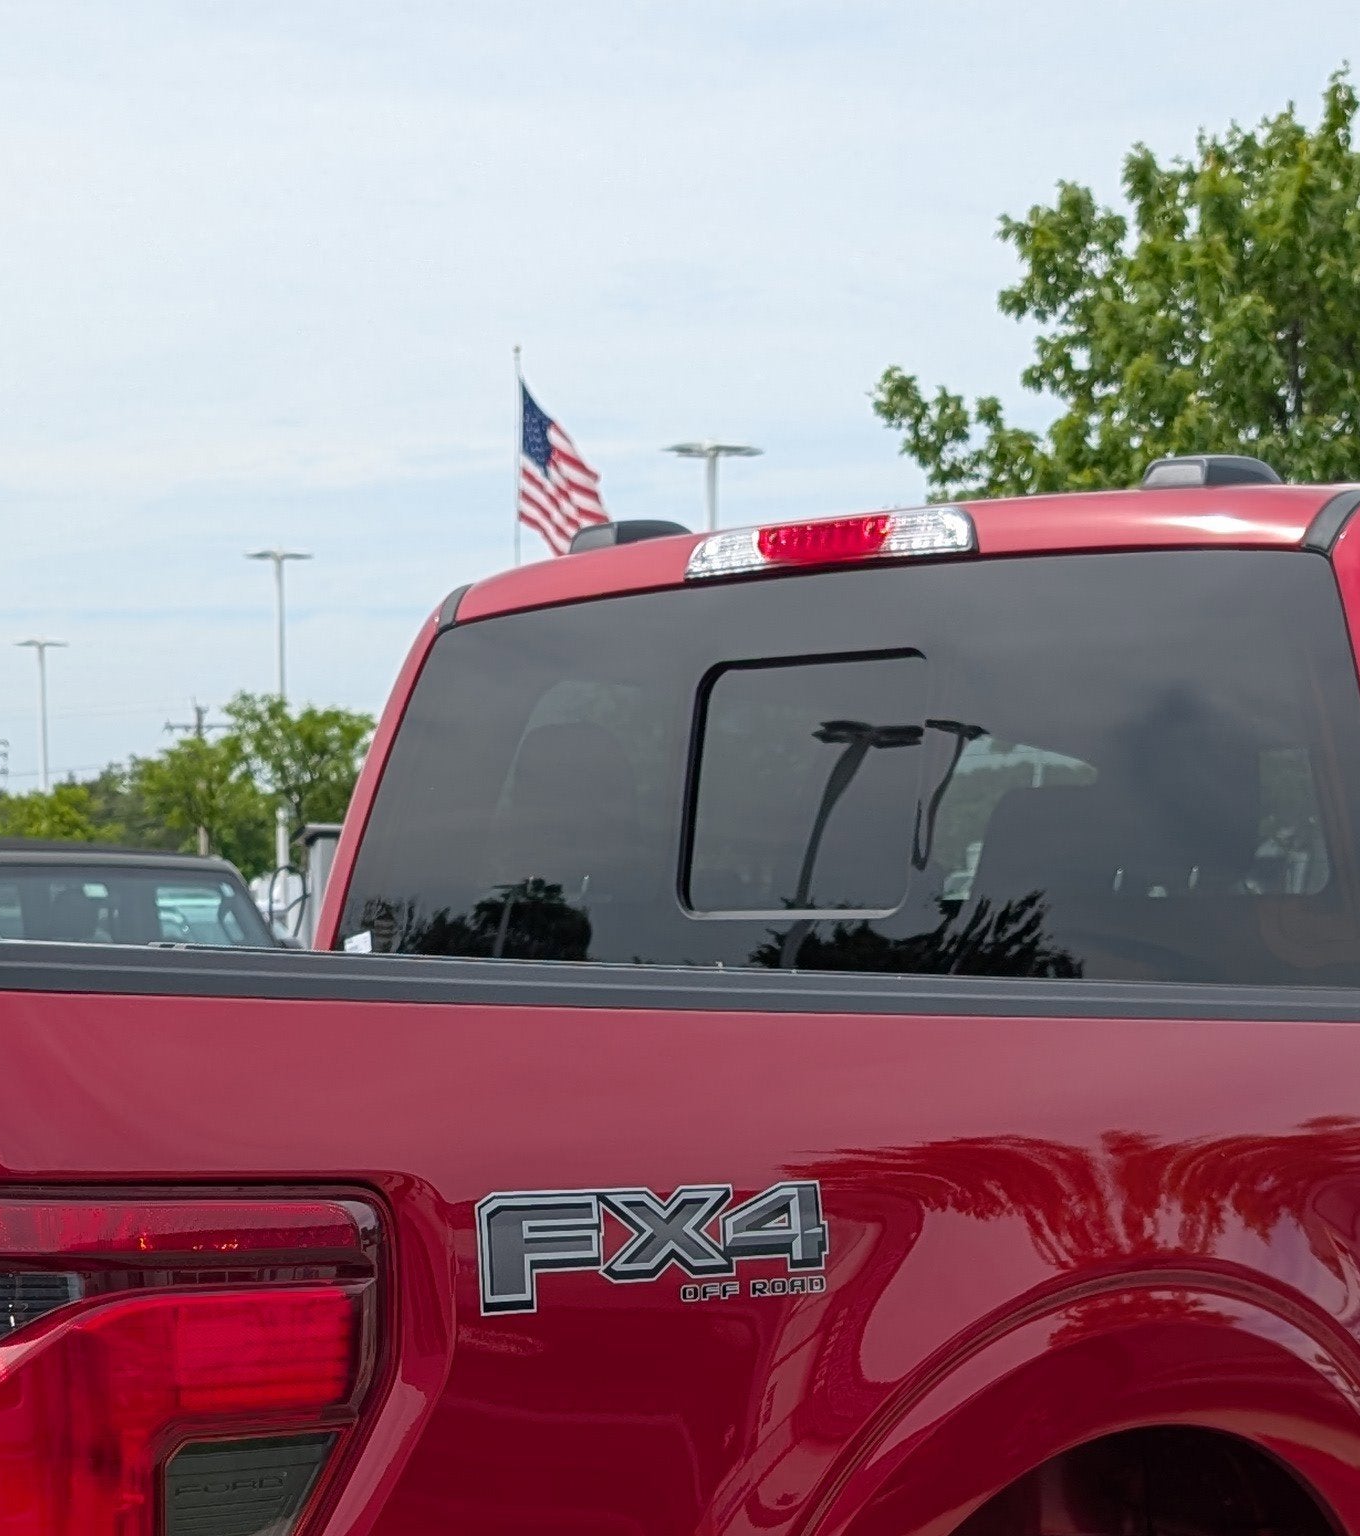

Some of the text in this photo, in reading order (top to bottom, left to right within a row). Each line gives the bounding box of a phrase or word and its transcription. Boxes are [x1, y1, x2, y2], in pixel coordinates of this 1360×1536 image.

[474, 1180, 830, 1317] FX4
[680, 1277, 826, 1303] OFF ROAD
[174, 1474, 285, 1497] FORD
